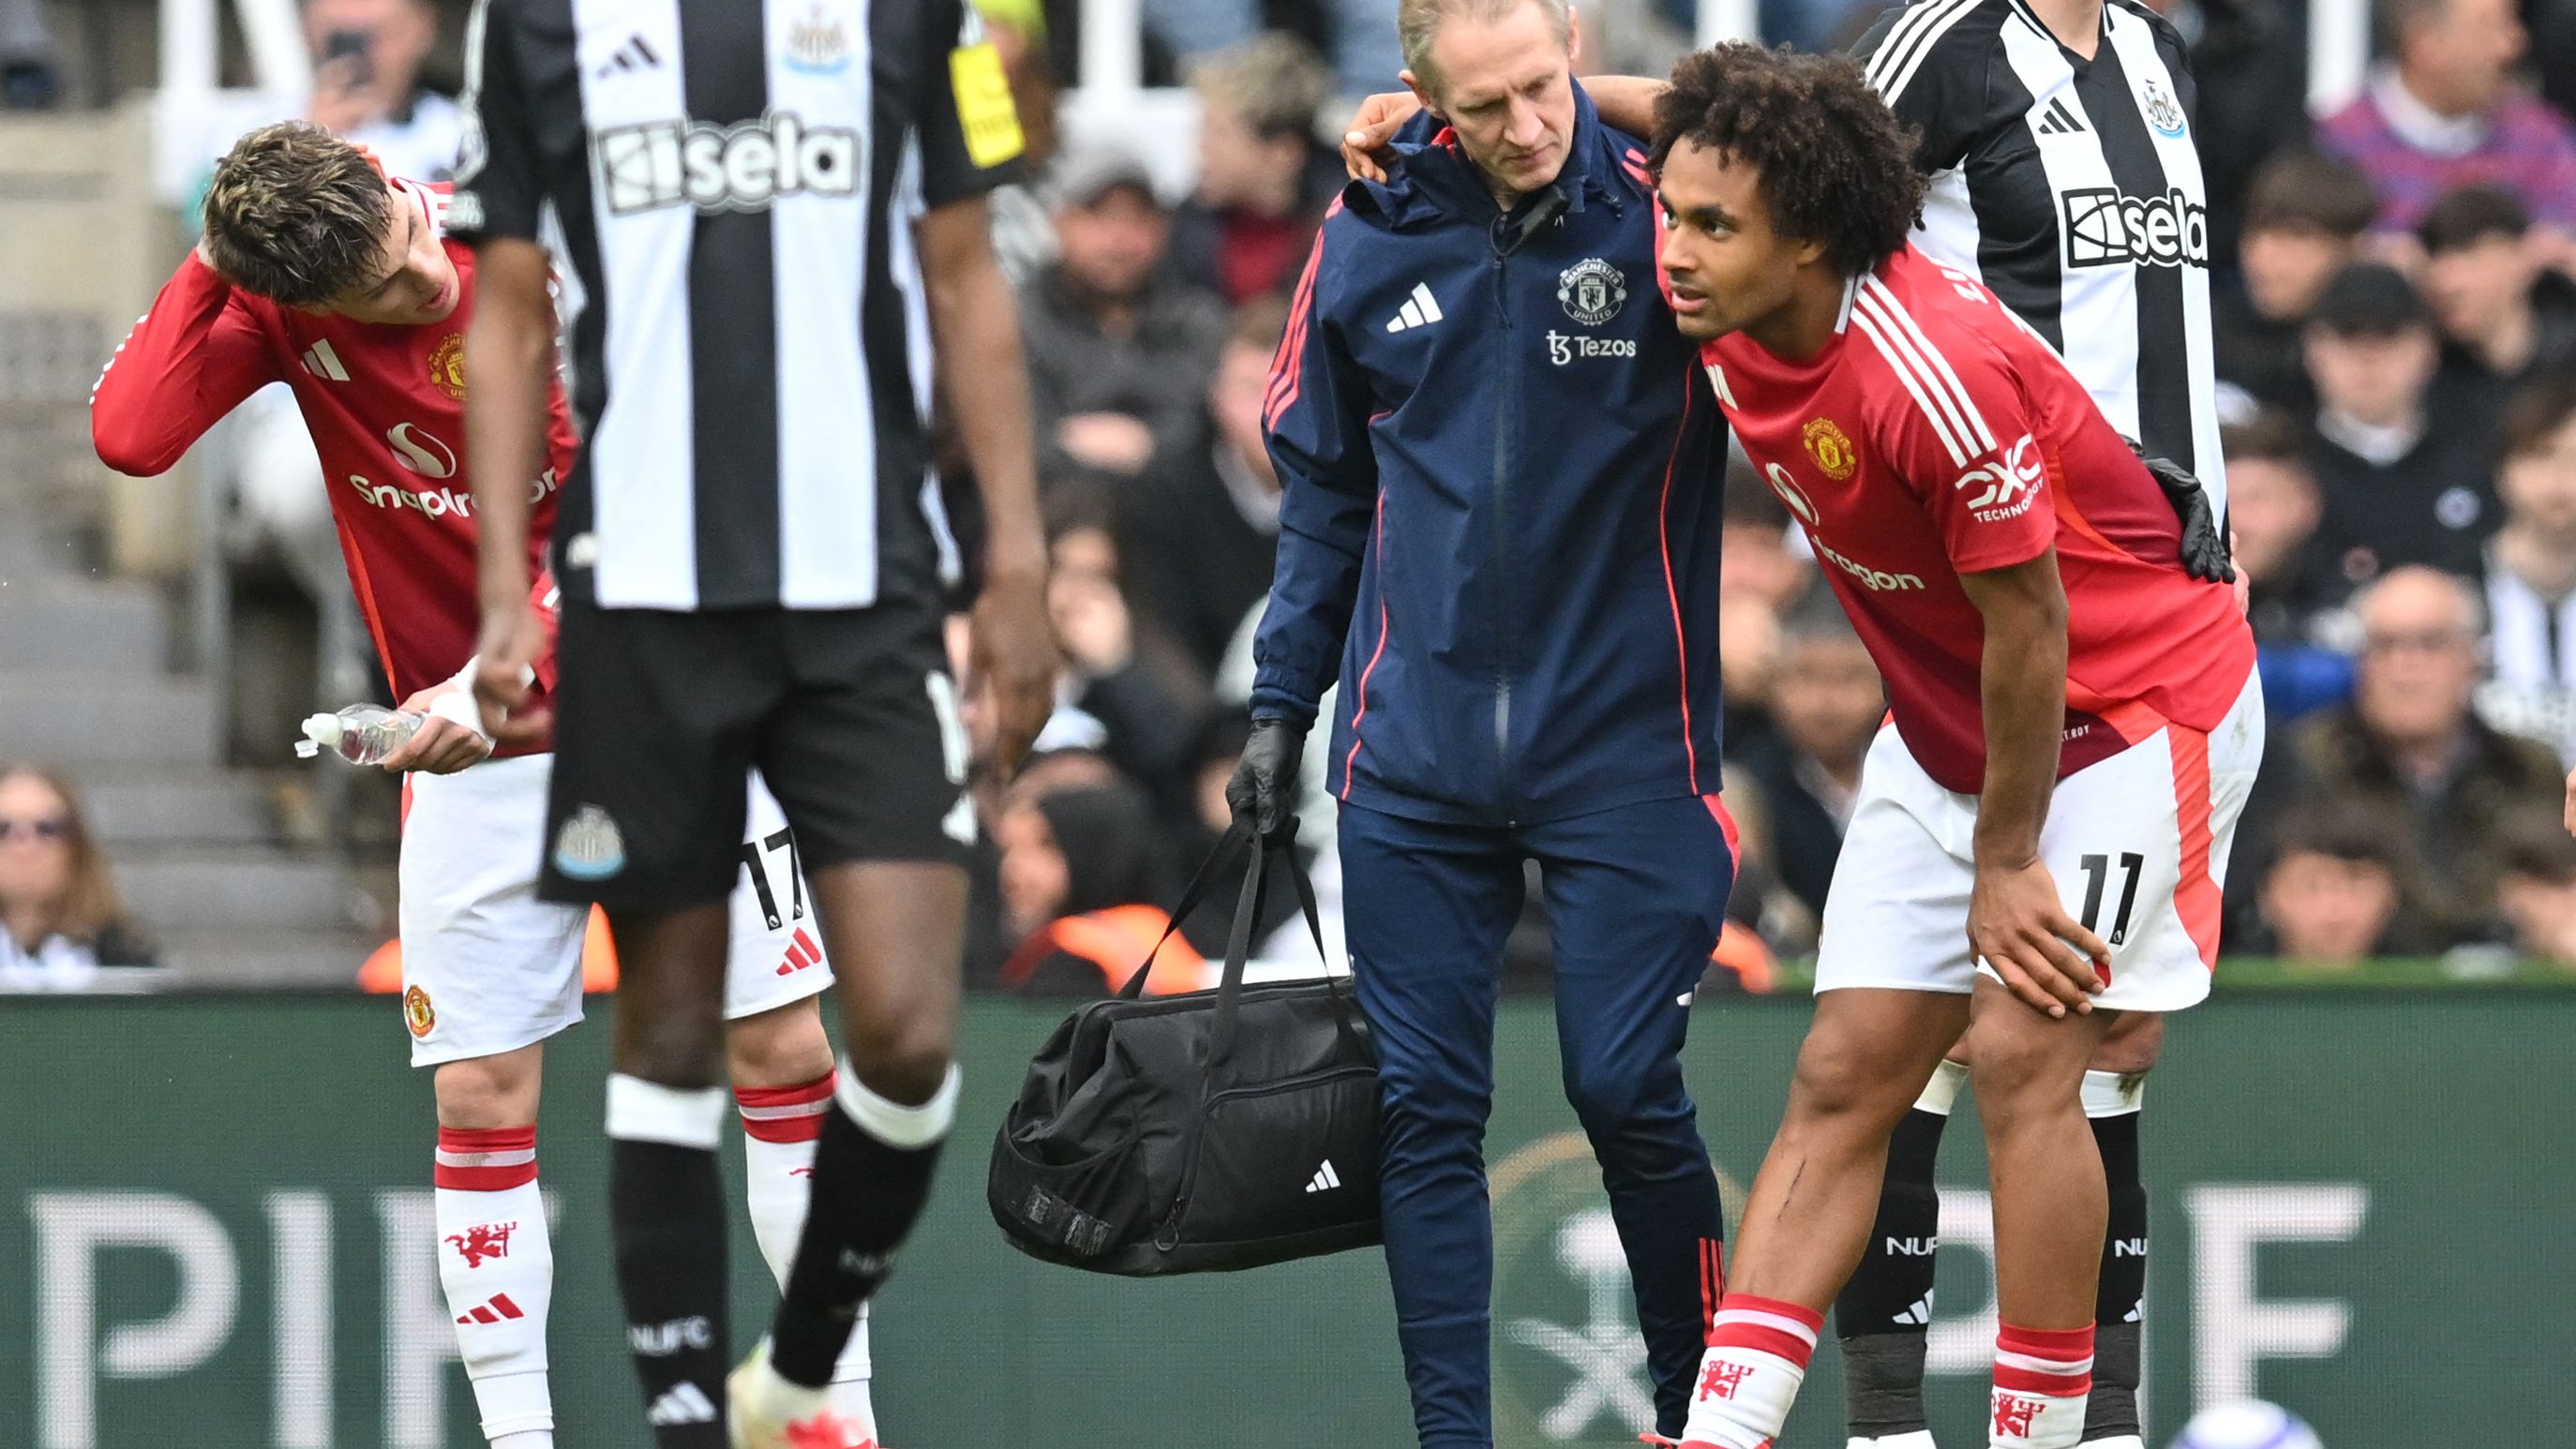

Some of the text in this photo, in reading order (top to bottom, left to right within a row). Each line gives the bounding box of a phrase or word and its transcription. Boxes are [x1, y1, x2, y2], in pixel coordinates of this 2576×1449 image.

[685, 118, 854, 197] sela
[2123, 195, 2209, 261] sela
[1565, 262, 1620, 285] MANCHESTER
[1573, 309, 1612, 321] UNITED
[1574, 336, 1637, 358] Tezos
[741, 825, 804, 932] 17
[2079, 851, 2145, 947] 11
[627, 1316, 713, 1358] NUFC
